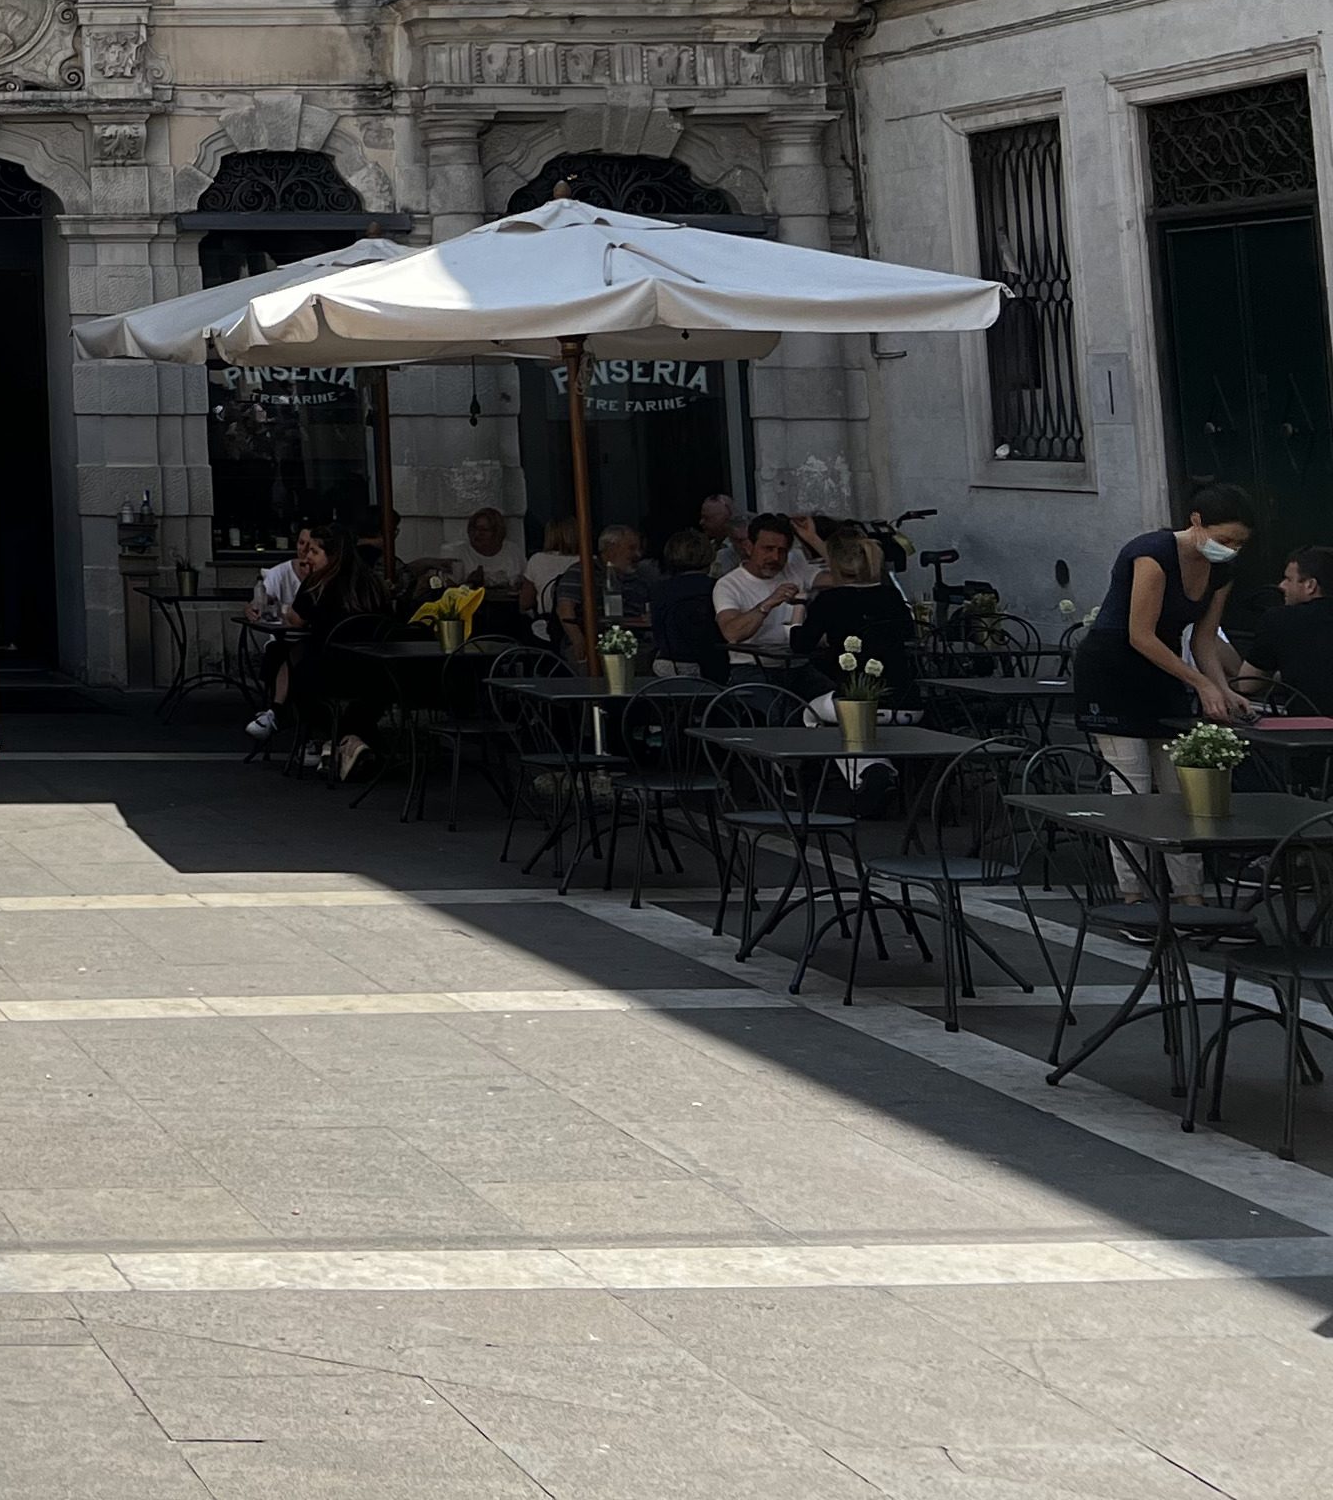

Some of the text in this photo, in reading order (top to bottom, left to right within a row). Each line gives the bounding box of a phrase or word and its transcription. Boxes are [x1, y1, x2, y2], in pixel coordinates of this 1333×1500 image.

[550, 359, 708, 395] PNSERIA
[584, 396, 687, 412] TRE FARINE
